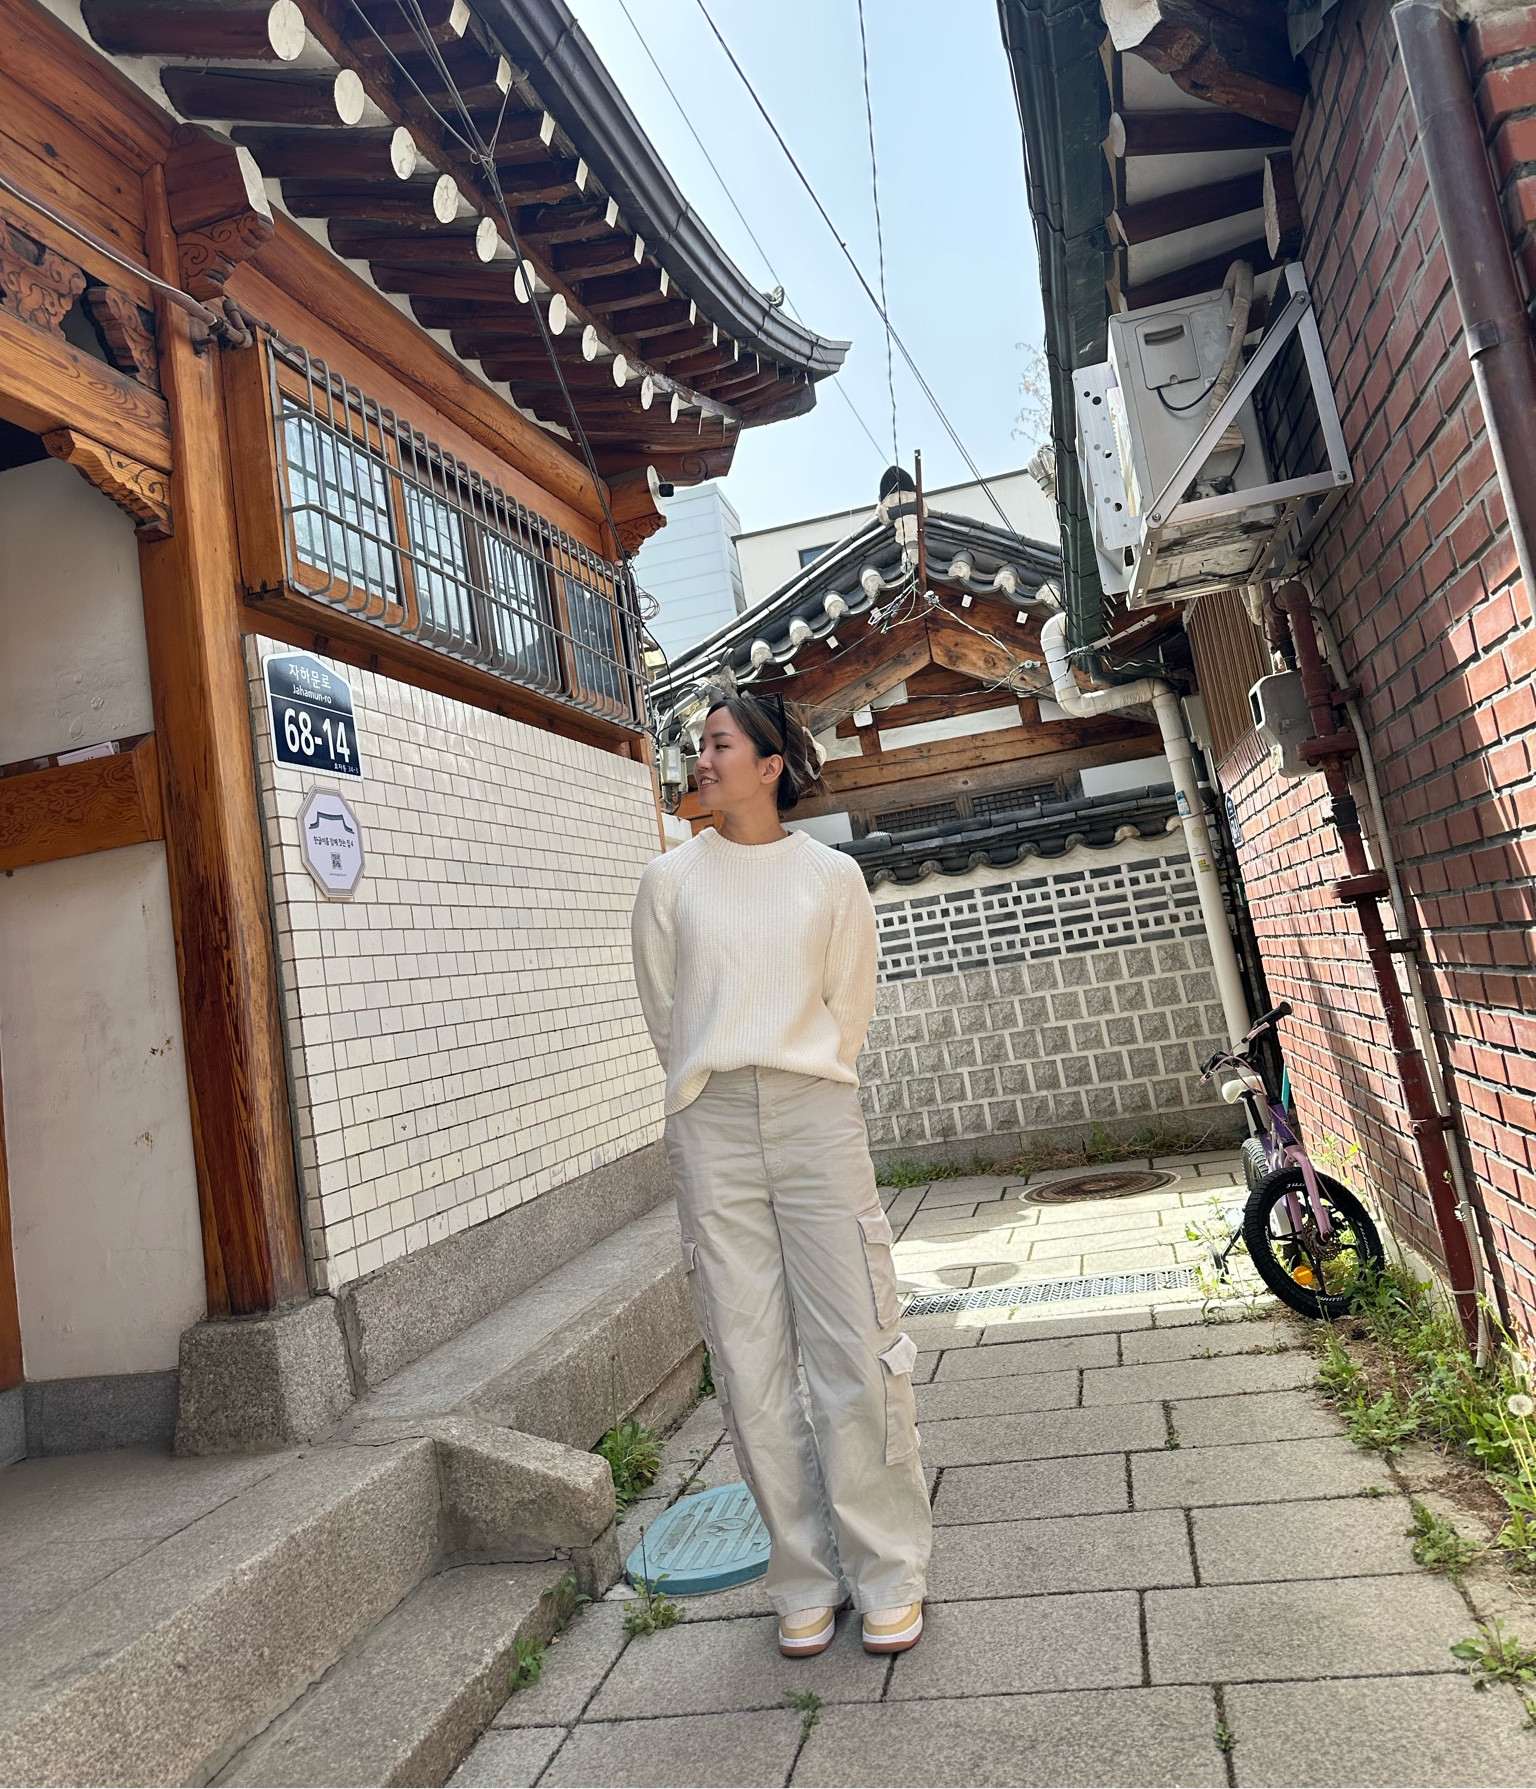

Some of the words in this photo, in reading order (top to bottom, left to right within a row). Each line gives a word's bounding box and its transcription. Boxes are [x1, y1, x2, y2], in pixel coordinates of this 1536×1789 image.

[289, 664, 331, 689] 자하문로
[293, 684, 332, 704] Jahamun-ro
[284, 708, 350, 763] 68-14
[334, 763, 347, 773] 효자동
